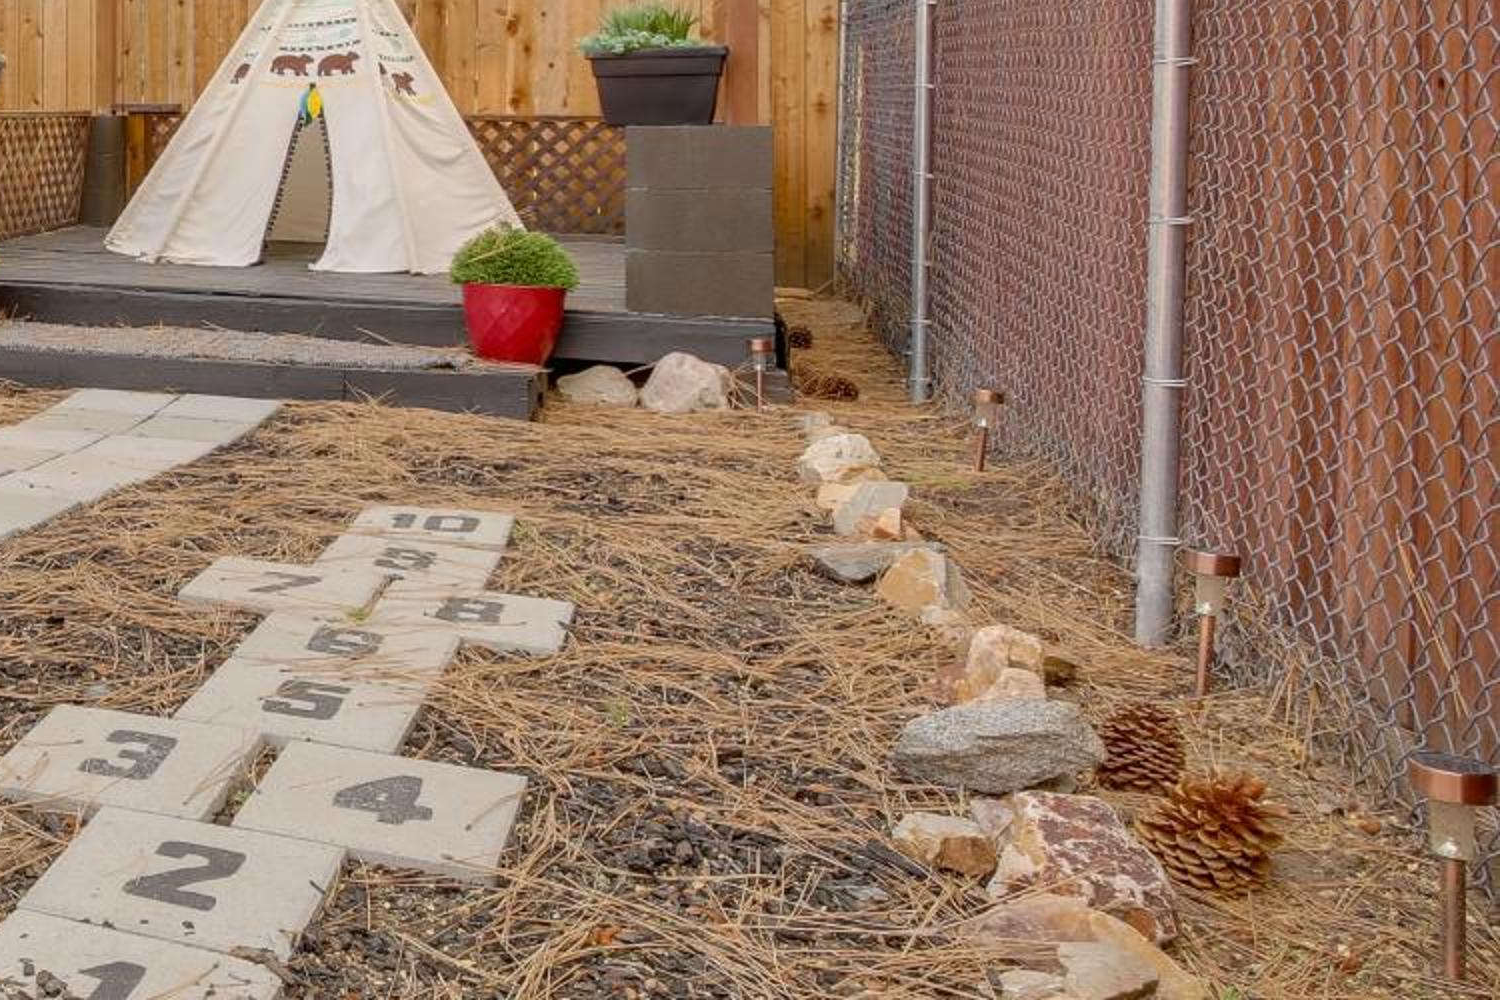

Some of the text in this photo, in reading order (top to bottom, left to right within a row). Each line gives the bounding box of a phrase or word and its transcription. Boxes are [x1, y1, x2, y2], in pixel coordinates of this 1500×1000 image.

[391, 513, 480, 533] 10
[373, 547, 436, 572] 9
[250, 571, 321, 592] 7
[435, 598, 504, 624] 8
[306, 626, 383, 656] 6
[262, 680, 351, 720] 5
[78, 730, 177, 780] 3
[332, 775, 433, 825] 4
[123, 841, 246, 911] 2
